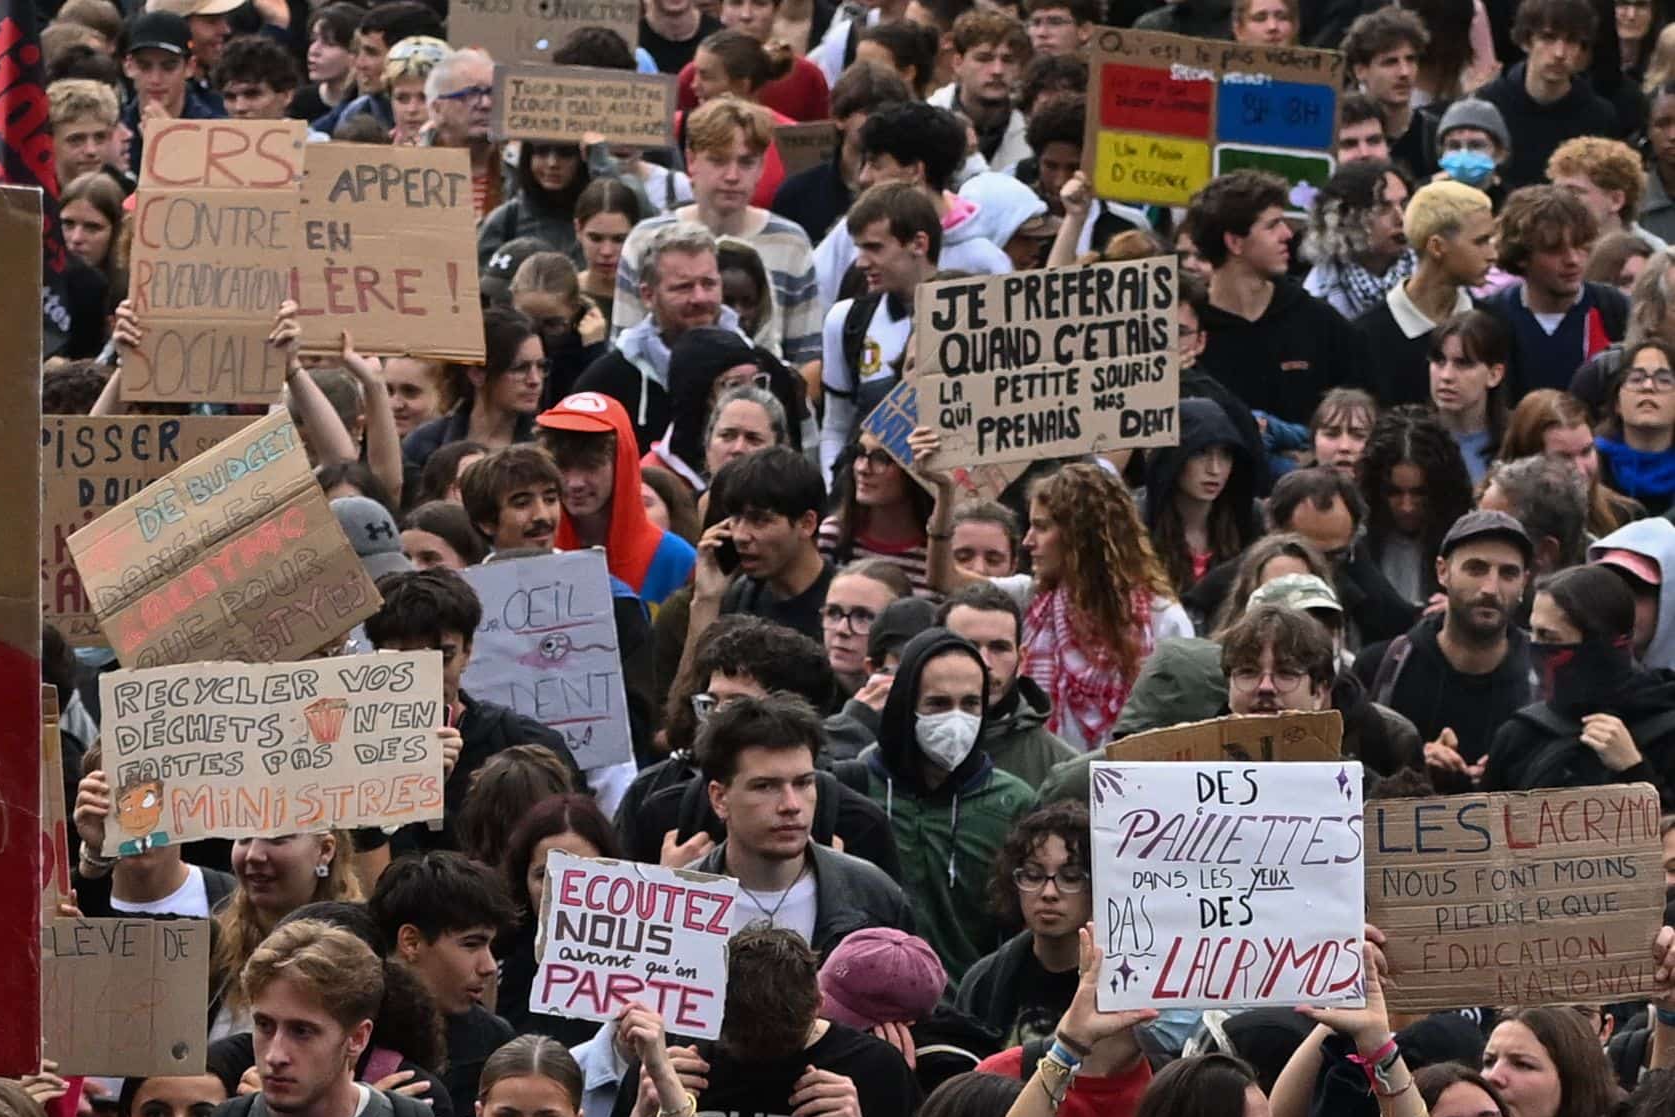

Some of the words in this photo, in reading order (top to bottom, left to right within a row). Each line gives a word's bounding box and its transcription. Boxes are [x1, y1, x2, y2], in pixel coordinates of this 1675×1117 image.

[146, 123, 296, 189] CRS
[328, 163, 469, 208] APPERT
[138, 195, 292, 252] CONTRE
[305, 220, 353, 252] EN
[932, 282, 987, 332] JE
[939, 326, 1042, 378] QUAND
[939, 380, 963, 405] LA
[1119, 406, 1175, 439] DENT
[186, 420, 298, 506] BUDGET
[114, 669, 319, 718] RECYCLER
[339, 662, 414, 693] VOS
[115, 710, 284, 755] DÉCHETS
[353, 701, 436, 735] N'EN
[262, 744, 333, 775] PAS
[355, 736, 428, 764] DES
[1196, 769, 1259, 805] DES
[1377, 802, 1491, 853] LES
[559, 869, 734, 935] ECOUTEZ
[1132, 871, 1188, 891] DANS
[1200, 868, 1233, 890] LES
[1247, 867, 1291, 898] YEUX
[1381, 867, 1458, 898] NOUS
[1475, 863, 1541, 894] FONT
[1554, 856, 1638, 882] MOINS
[555, 910, 674, 956] NOUS
[1107, 895, 1154, 954] PAS
[1199, 894, 1254, 929] DES
[1436, 896, 1551, 935] PLEURER
[1561, 891, 1621, 916] QUE
[559, 946, 635, 969] avant
[1151, 936, 1362, 1000] LACRYMOS
[541, 964, 715, 1028] PARTE
